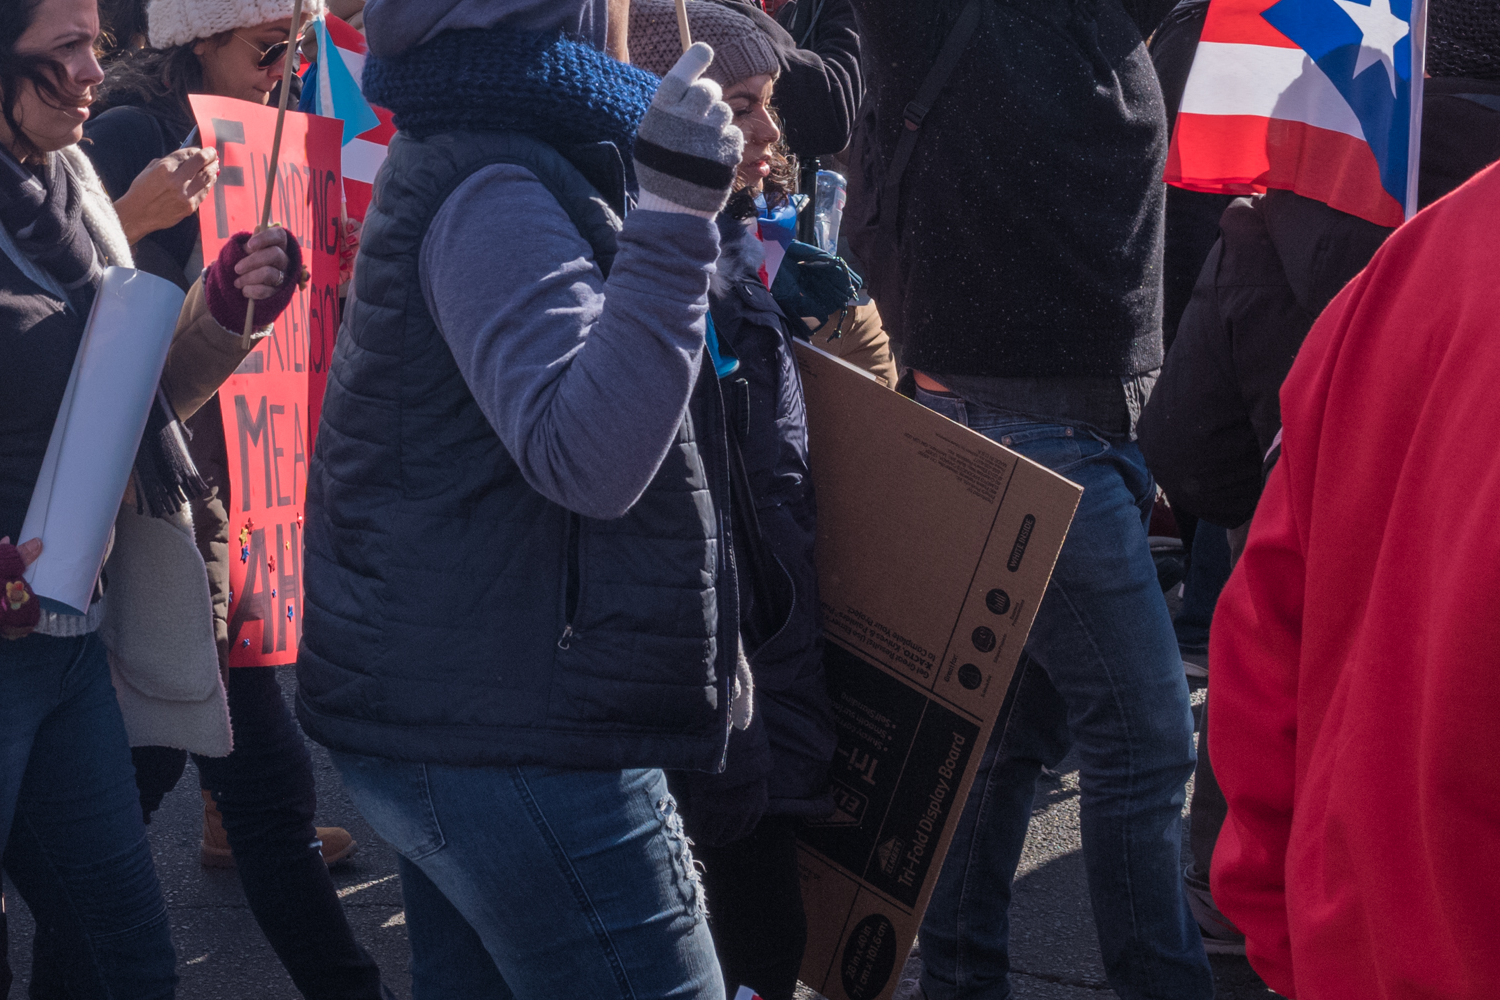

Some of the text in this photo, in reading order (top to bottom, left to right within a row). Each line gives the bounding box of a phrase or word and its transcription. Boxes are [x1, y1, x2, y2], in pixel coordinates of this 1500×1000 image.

[1009, 517, 1033, 567] WHITE INSIDE
[872, 620, 892, 636] Your
[874, 632, 901, 652] Knives
[890, 630, 929, 657] Complete
[893, 653, 917, 671] Great
[914, 666, 930, 679] Get
[896, 728, 967, 886] Tri-Fold Display Board
[844, 924, 872, 979] 28 in x 40 in
[852, 921, 888, 997] 71 cm x 101.6 cm
